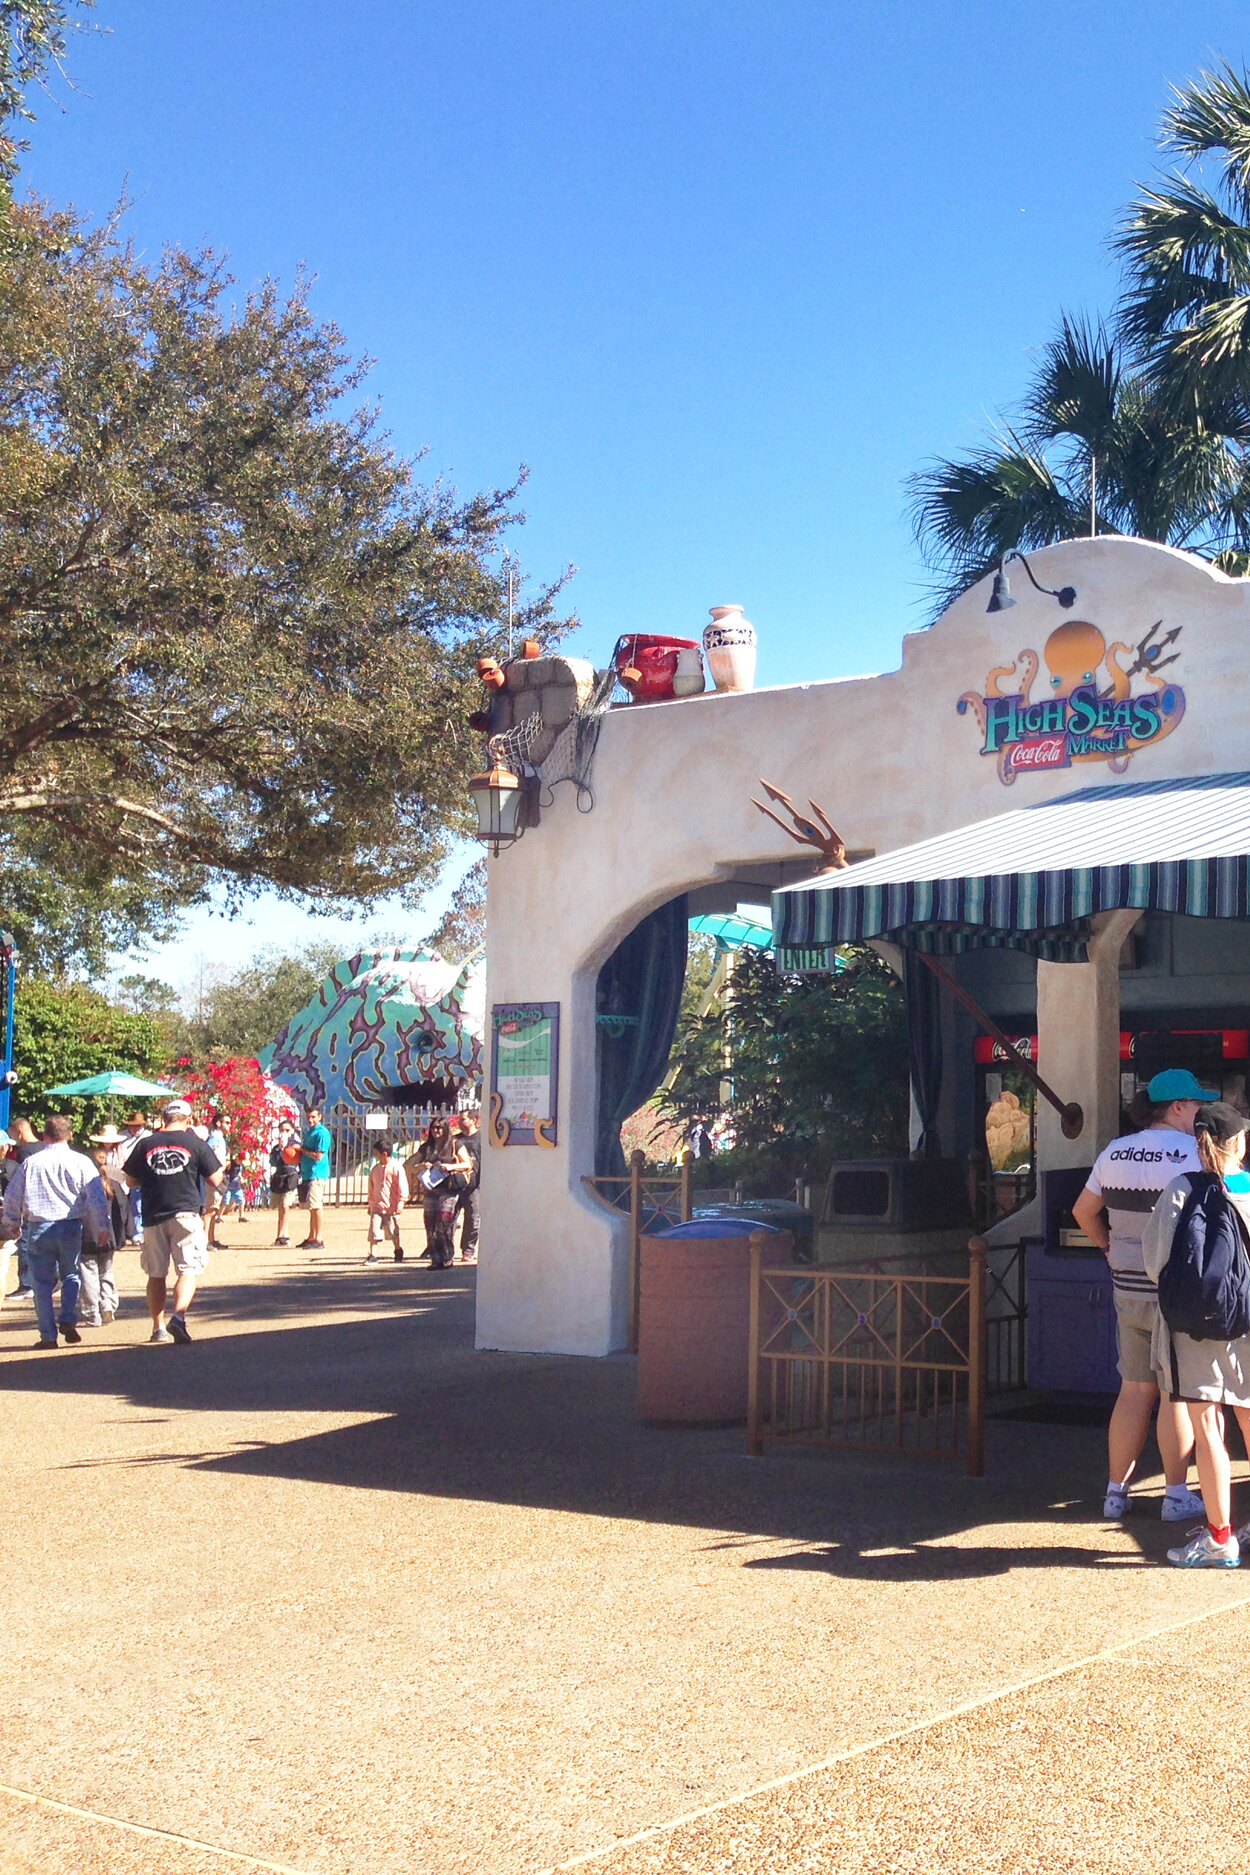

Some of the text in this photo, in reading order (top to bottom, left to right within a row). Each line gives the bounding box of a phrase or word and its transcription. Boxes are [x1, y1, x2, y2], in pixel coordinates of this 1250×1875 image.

[981, 686, 1161, 754] HIGH SEAS
[1010, 740, 1063, 766] Coca-Cola
[1110, 1147, 1163, 1162] adidas
